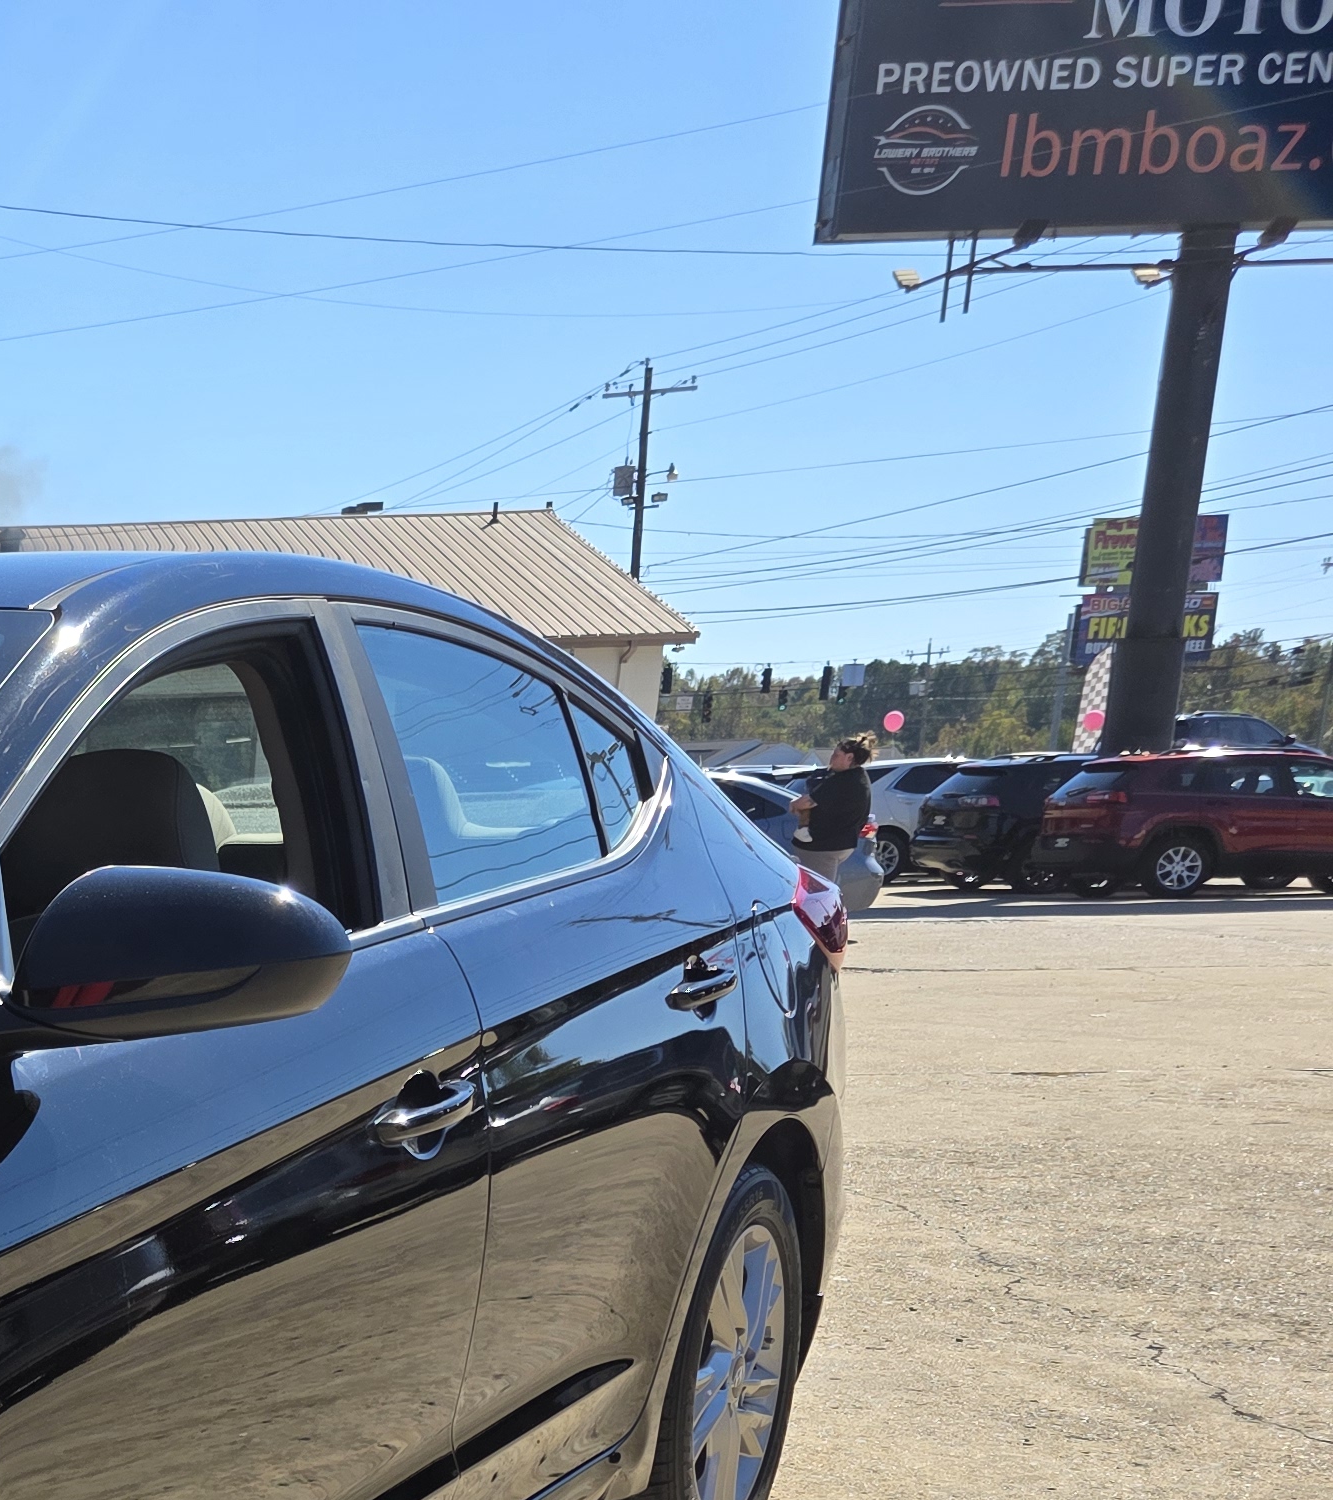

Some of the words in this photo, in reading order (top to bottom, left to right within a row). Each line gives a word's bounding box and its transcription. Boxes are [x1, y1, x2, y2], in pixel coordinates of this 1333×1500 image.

[876, 57, 1101, 94] PREOWNED
[1112, 54, 1245, 88] SUPER
[1258, 51, 1333, 85] CEN
[874, 148, 920, 158] LOWERY
[921, 146, 979, 157] BROTHERS
